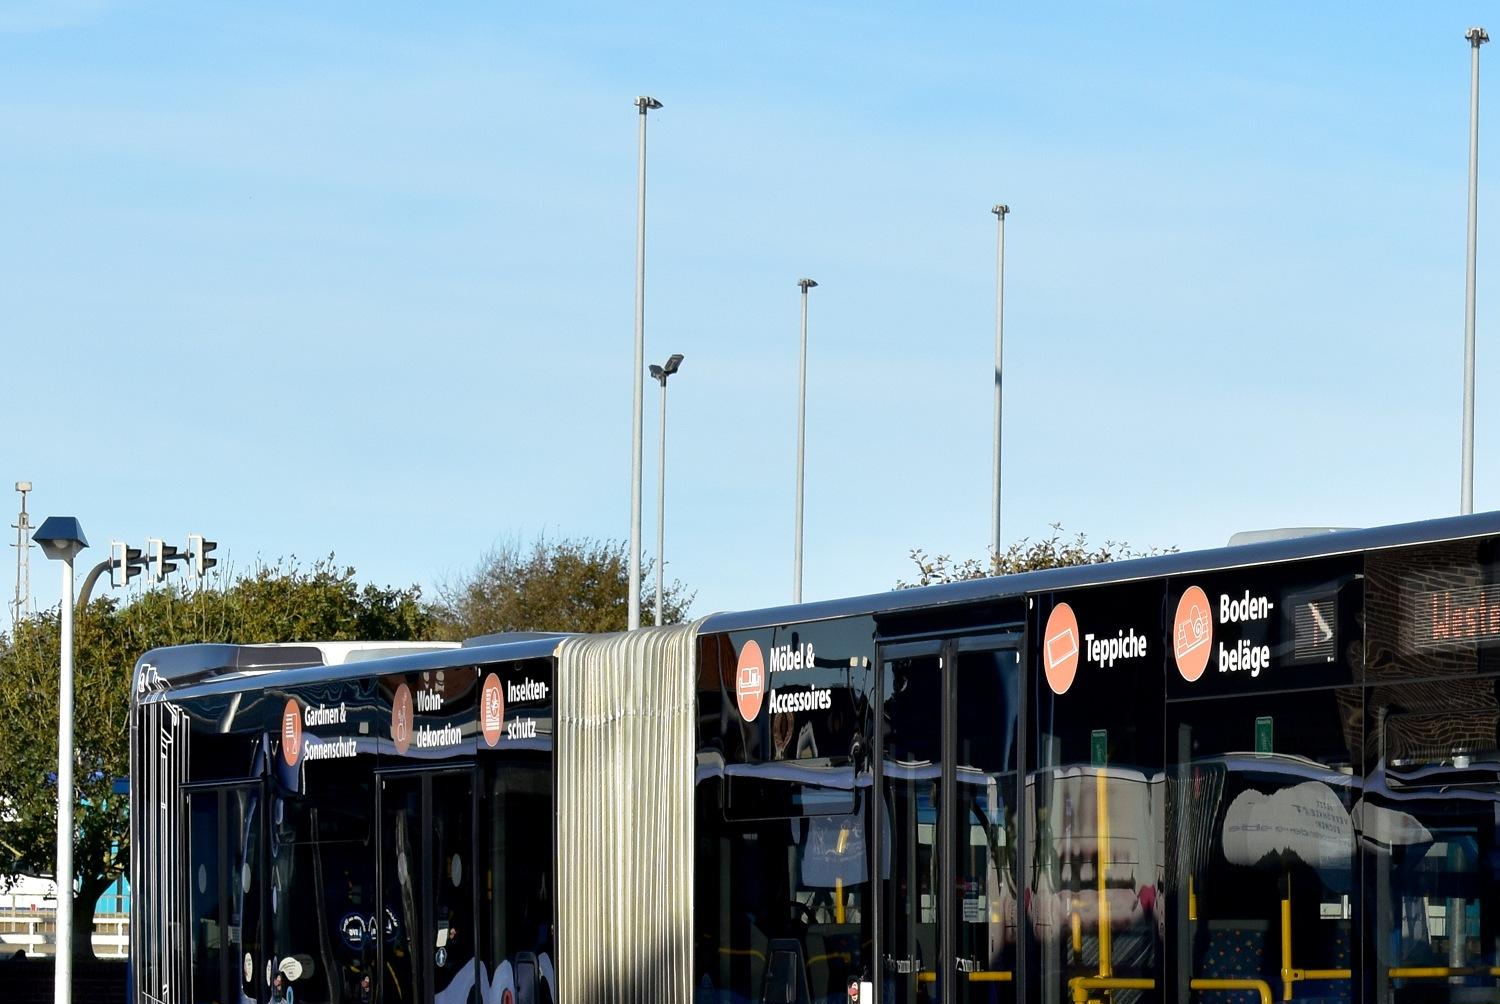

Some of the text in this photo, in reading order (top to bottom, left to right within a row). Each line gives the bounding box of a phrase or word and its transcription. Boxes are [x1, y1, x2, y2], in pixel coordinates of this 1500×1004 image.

[1219, 589, 1274, 624] Boden-
[769, 642, 815, 673] Möbel &
[1085, 628, 1147, 669] Teppiche
[1219, 640, 1270, 678] beläge
[417, 689, 444, 712] Wohn-
[507, 678, 549, 703] Insekten-
[769, 684, 832, 714] Accessoires
[304, 702, 347, 727] Gardinen &
[417, 723, 462, 748] dekoration
[507, 716, 537, 740] schutz
[304, 737, 357, 760] Sonnenschutz
